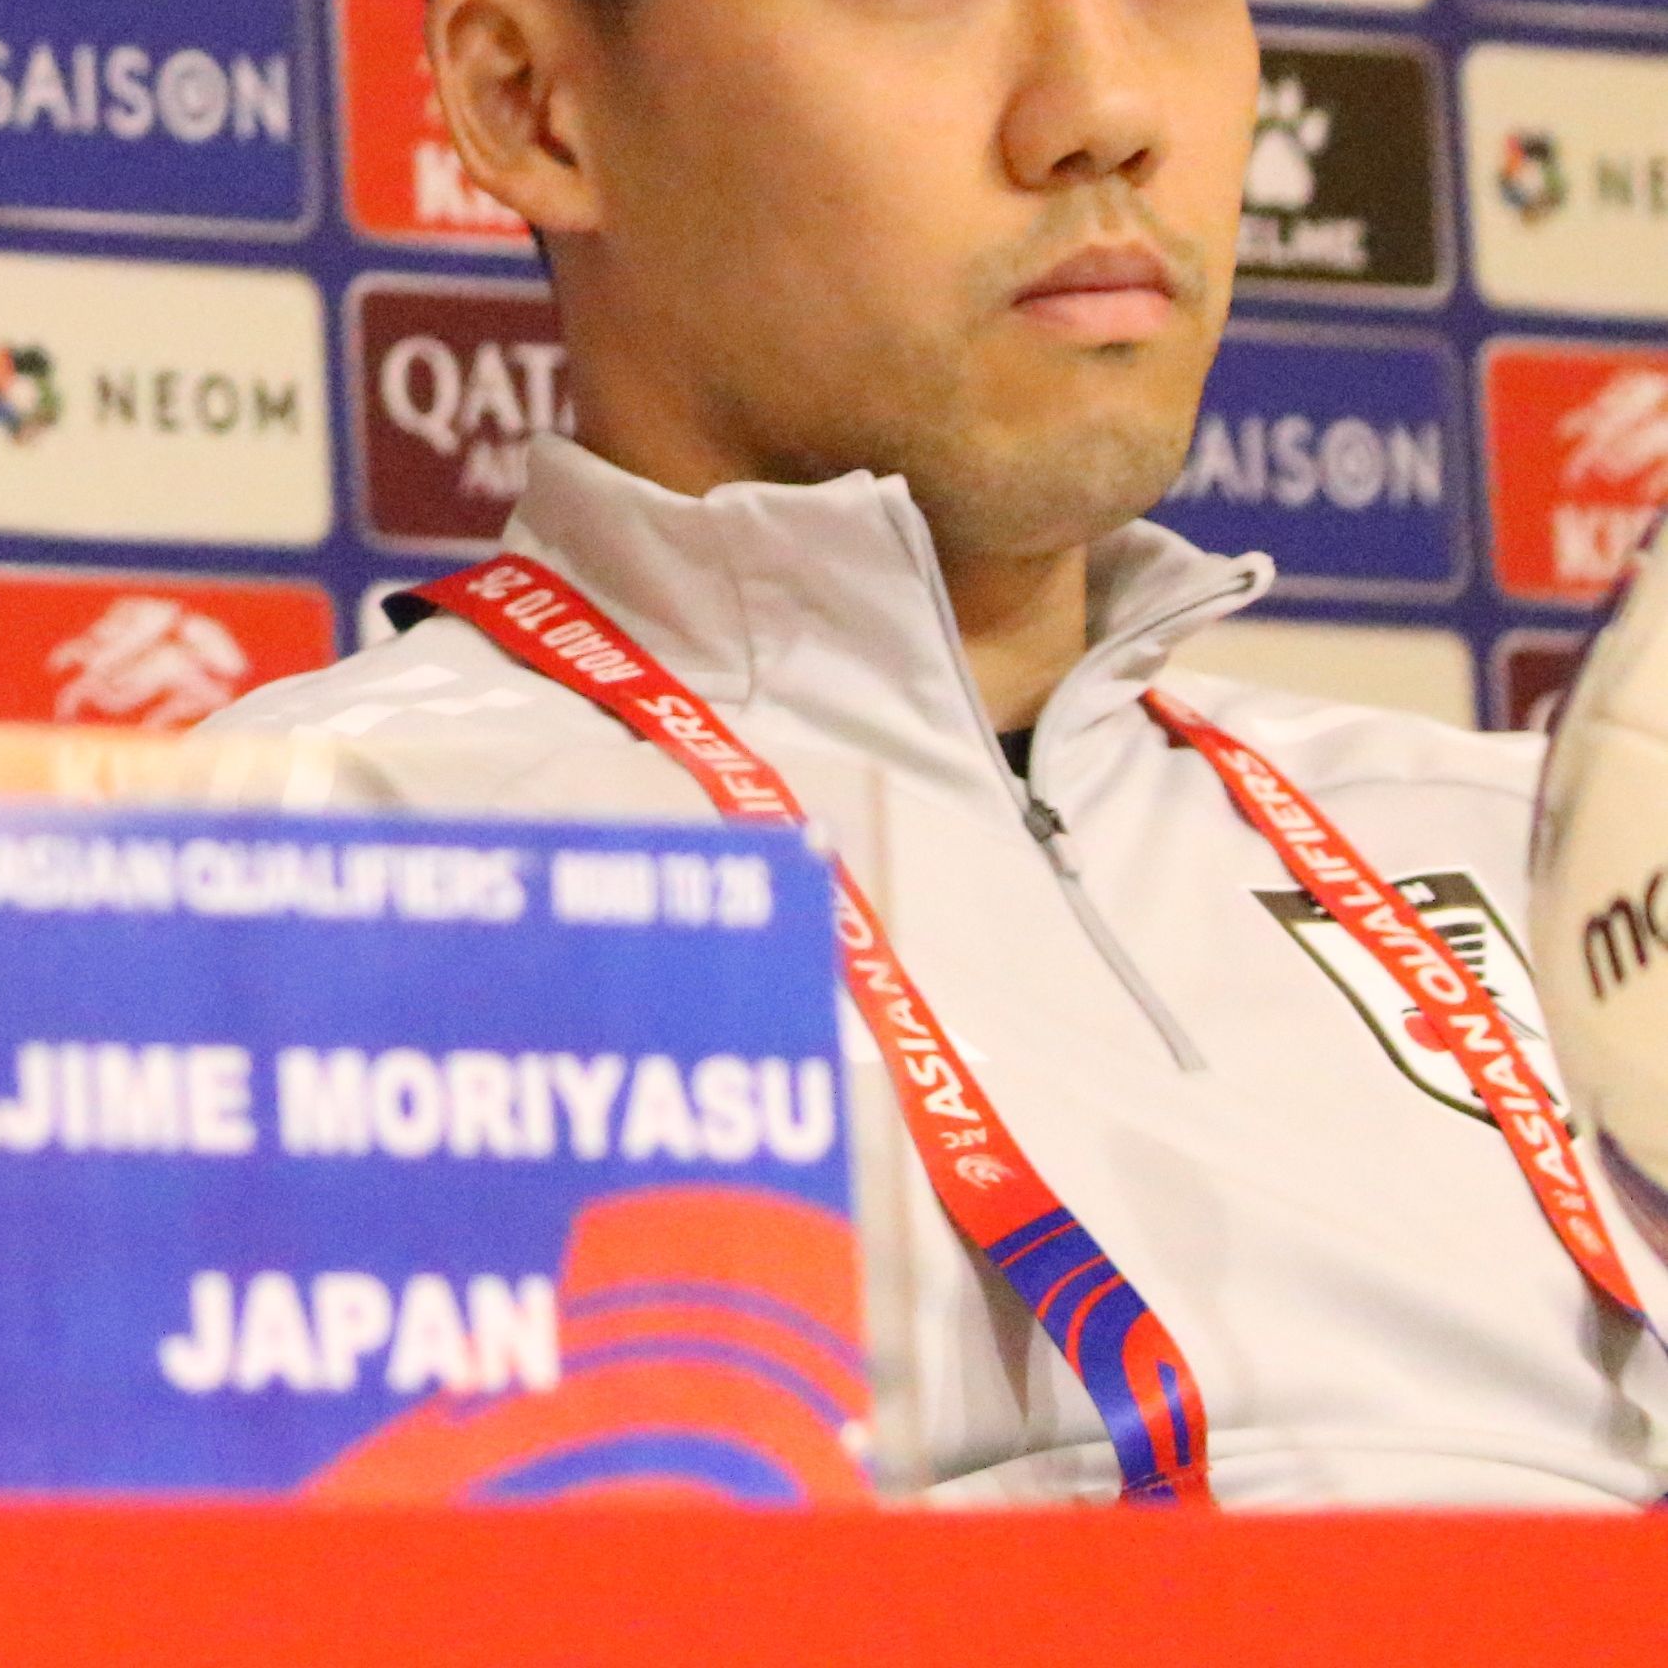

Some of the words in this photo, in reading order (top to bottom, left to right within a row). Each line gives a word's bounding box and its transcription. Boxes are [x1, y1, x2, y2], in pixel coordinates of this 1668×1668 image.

[93, 366, 301, 436] NEOM
[1172, 414, 1442, 509] AISON
[465, 564, 533, 601] 26
[505, 588, 571, 637] TO
[541, 618, 646, 687] ROAD
[1218, 747, 1468, 1006] QUALIFIERS
[852, 958, 982, 1122] ASIAN
[276, 1044, 841, 1164] MORIYASU
[1448, 1013, 1579, 1188] ASIAN
[158, 1268, 562, 1395] JAPAN
